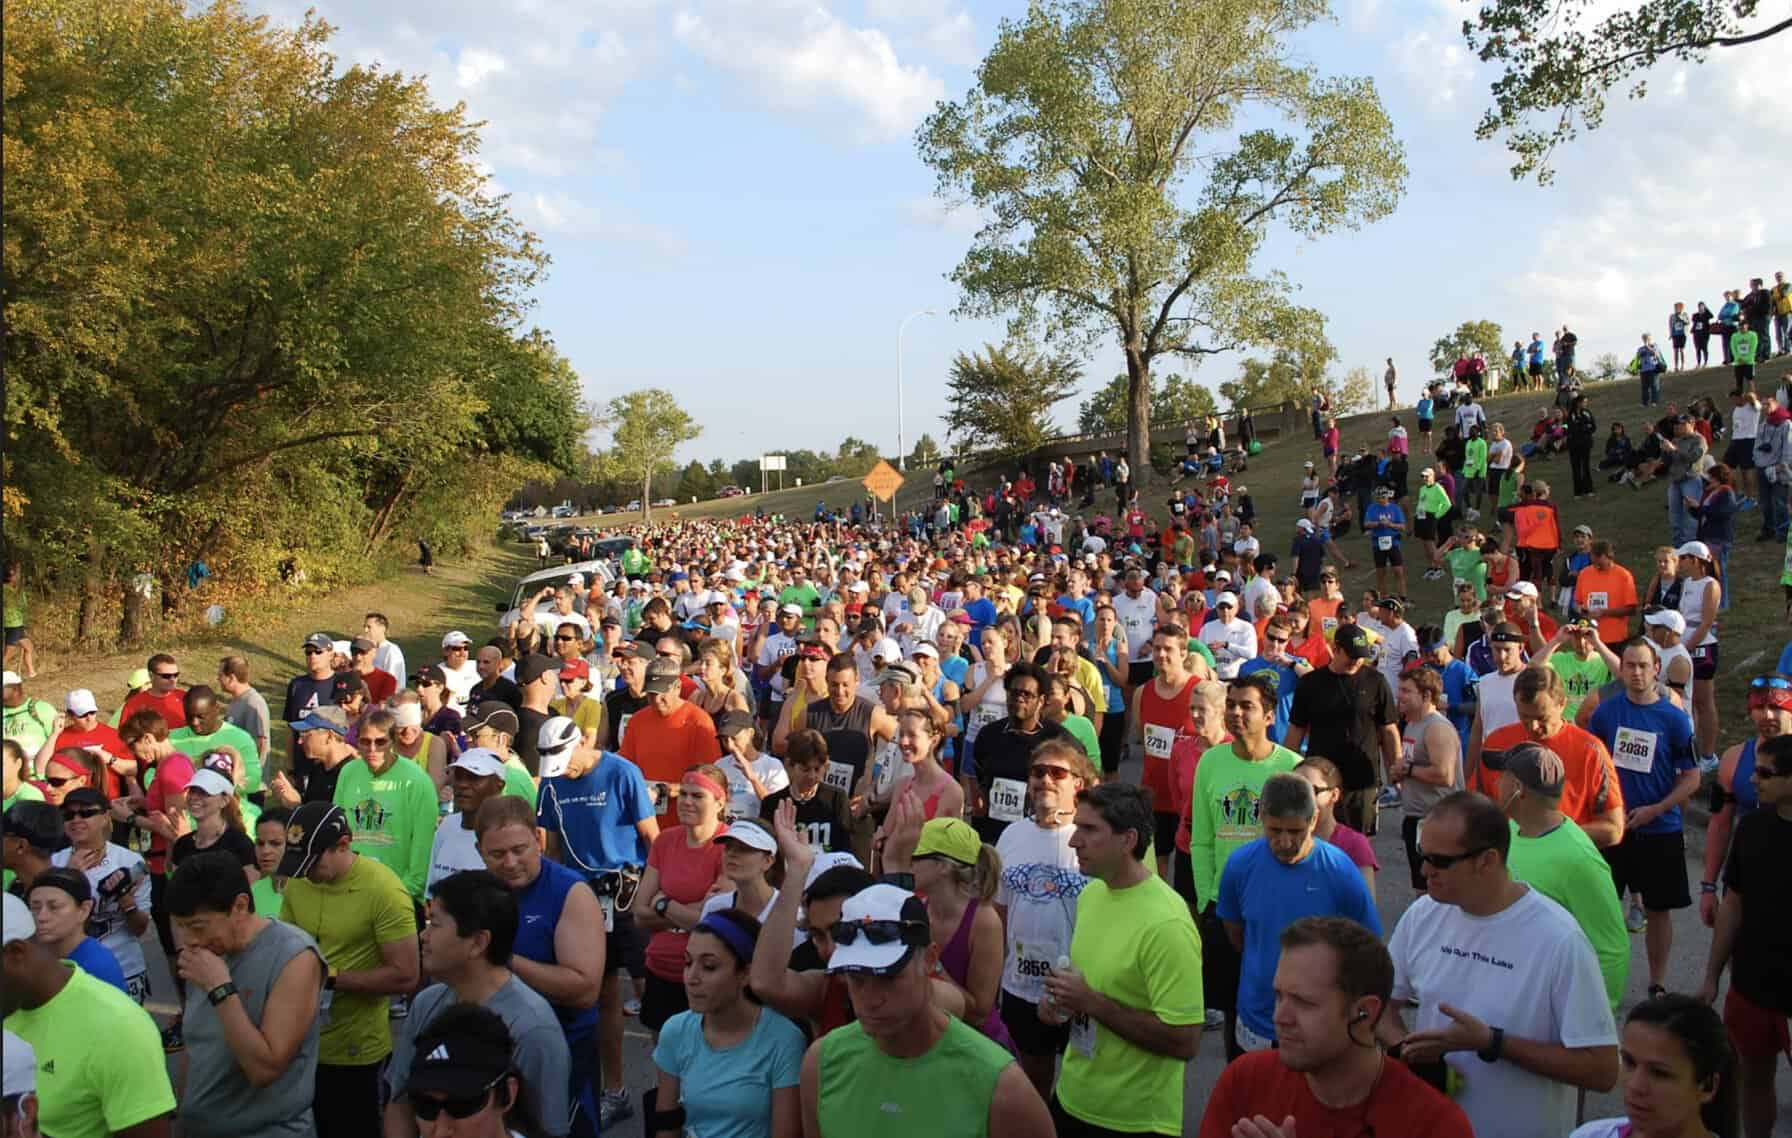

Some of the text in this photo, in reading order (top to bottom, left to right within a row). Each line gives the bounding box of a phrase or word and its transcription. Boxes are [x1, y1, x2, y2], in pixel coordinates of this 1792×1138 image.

[1147, 735, 1168, 751] 2731
[1619, 741, 1649, 758] 2038
[994, 791, 1018, 808] 1704
[1454, 949, 1470, 959] Run
[1471, 952, 1489, 963] This
[1491, 956, 1514, 970] Lake
